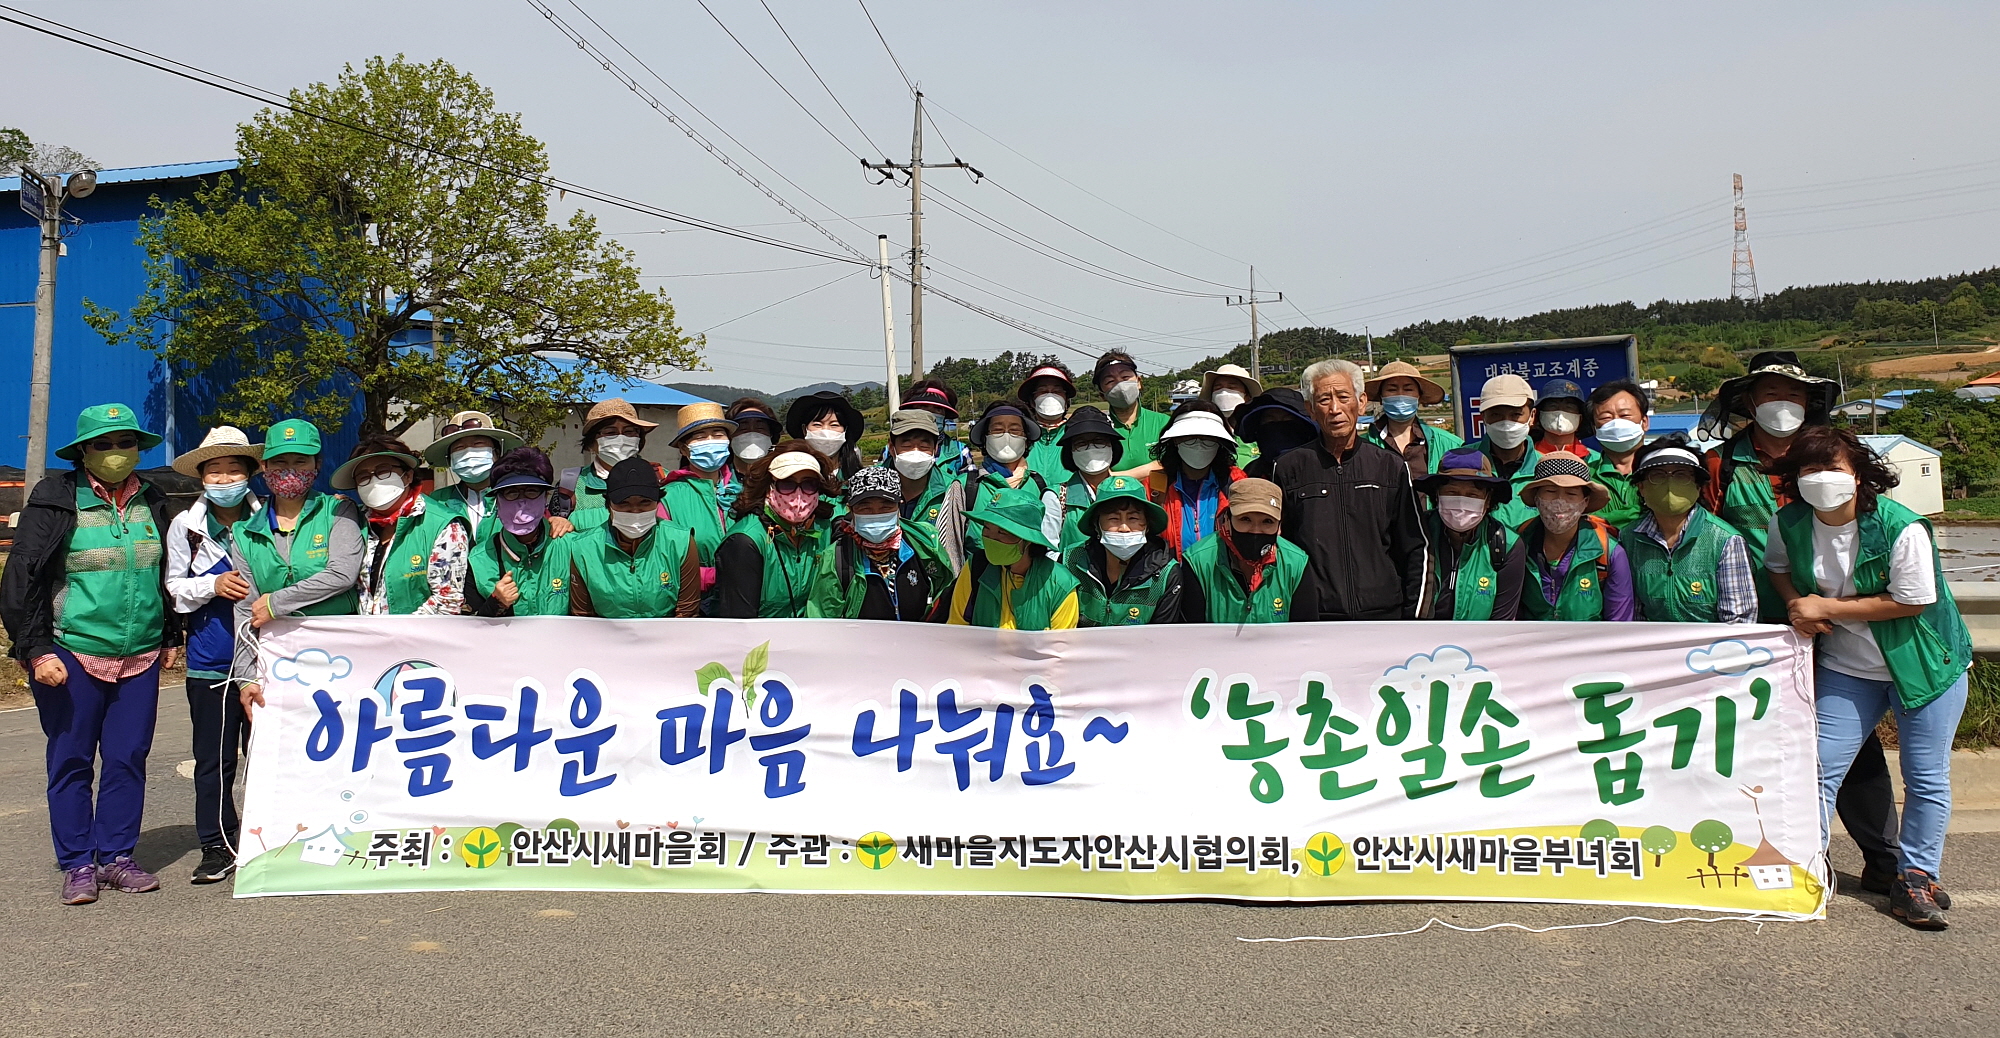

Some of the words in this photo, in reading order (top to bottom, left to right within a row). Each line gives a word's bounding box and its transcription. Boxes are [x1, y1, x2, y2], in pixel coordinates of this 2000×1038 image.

[1485, 357, 1600, 381] 대한불교조계종
[306, 678, 615, 797] 아름다운
[657, 681, 810, 798] 마음
[369, 833, 430, 866] 주최
[514, 831, 725, 865] 안산시새마을회
[739, 833, 755, 865] /
[769, 834, 830, 865] 주관
[903, 835, 1298, 874] 새마을지도자안산시협의회,
[1354, 837, 1640, 876] 안산시새마을부녀회
